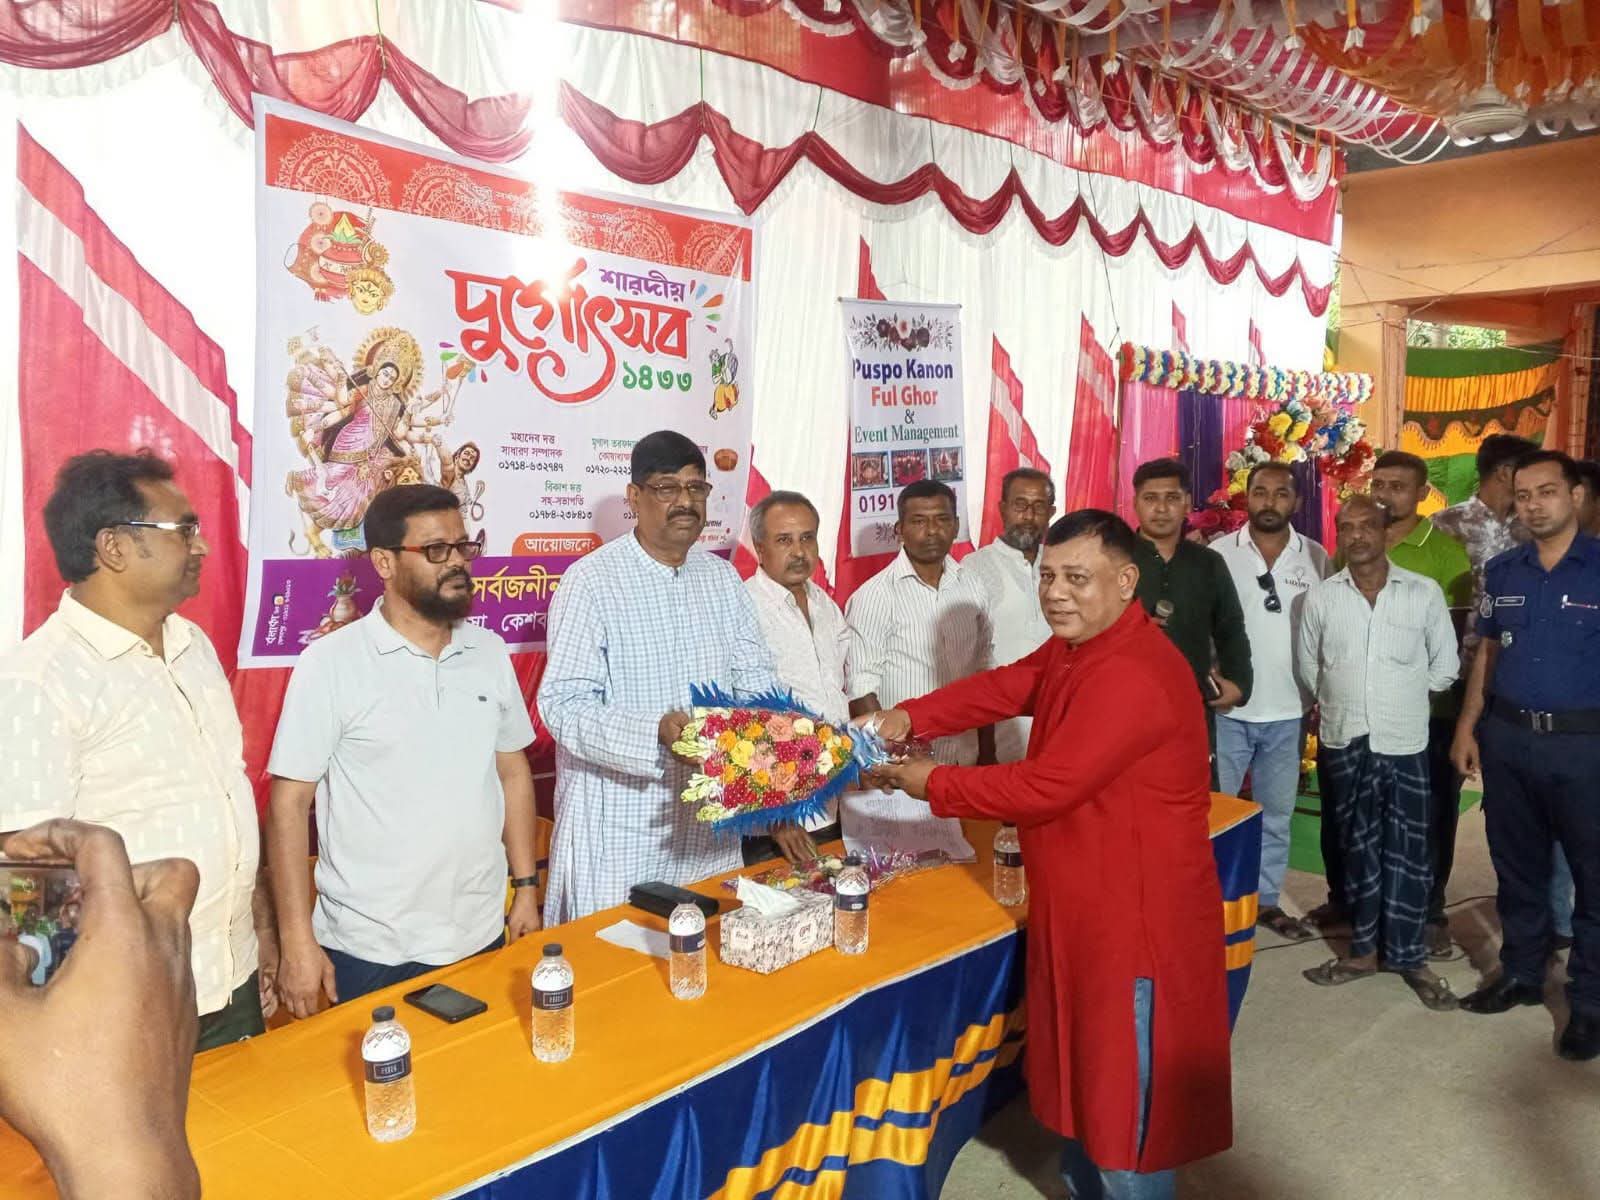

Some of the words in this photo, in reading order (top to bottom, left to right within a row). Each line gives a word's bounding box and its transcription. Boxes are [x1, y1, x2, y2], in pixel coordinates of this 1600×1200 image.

[622, 361, 692, 392] ১৪৩৩
[853, 359, 902, 384] Puspo
[906, 359, 953, 379] Kanon
[872, 385, 897, 406] Ful
[901, 385, 938, 406] Ghor
[904, 409, 915, 424] &
[511, 432, 541, 444] মহাদেব
[542, 434, 555, 445] দত্ত
[855, 426, 888, 443] Event
[891, 424, 959, 443] Management
[501, 445, 529, 457] সাধারণ
[531, 447, 564, 458] সম্পাদক
[545, 480, 567, 492] বিকাশ
[541, 494, 585, 506] সহ-সভাপতি
